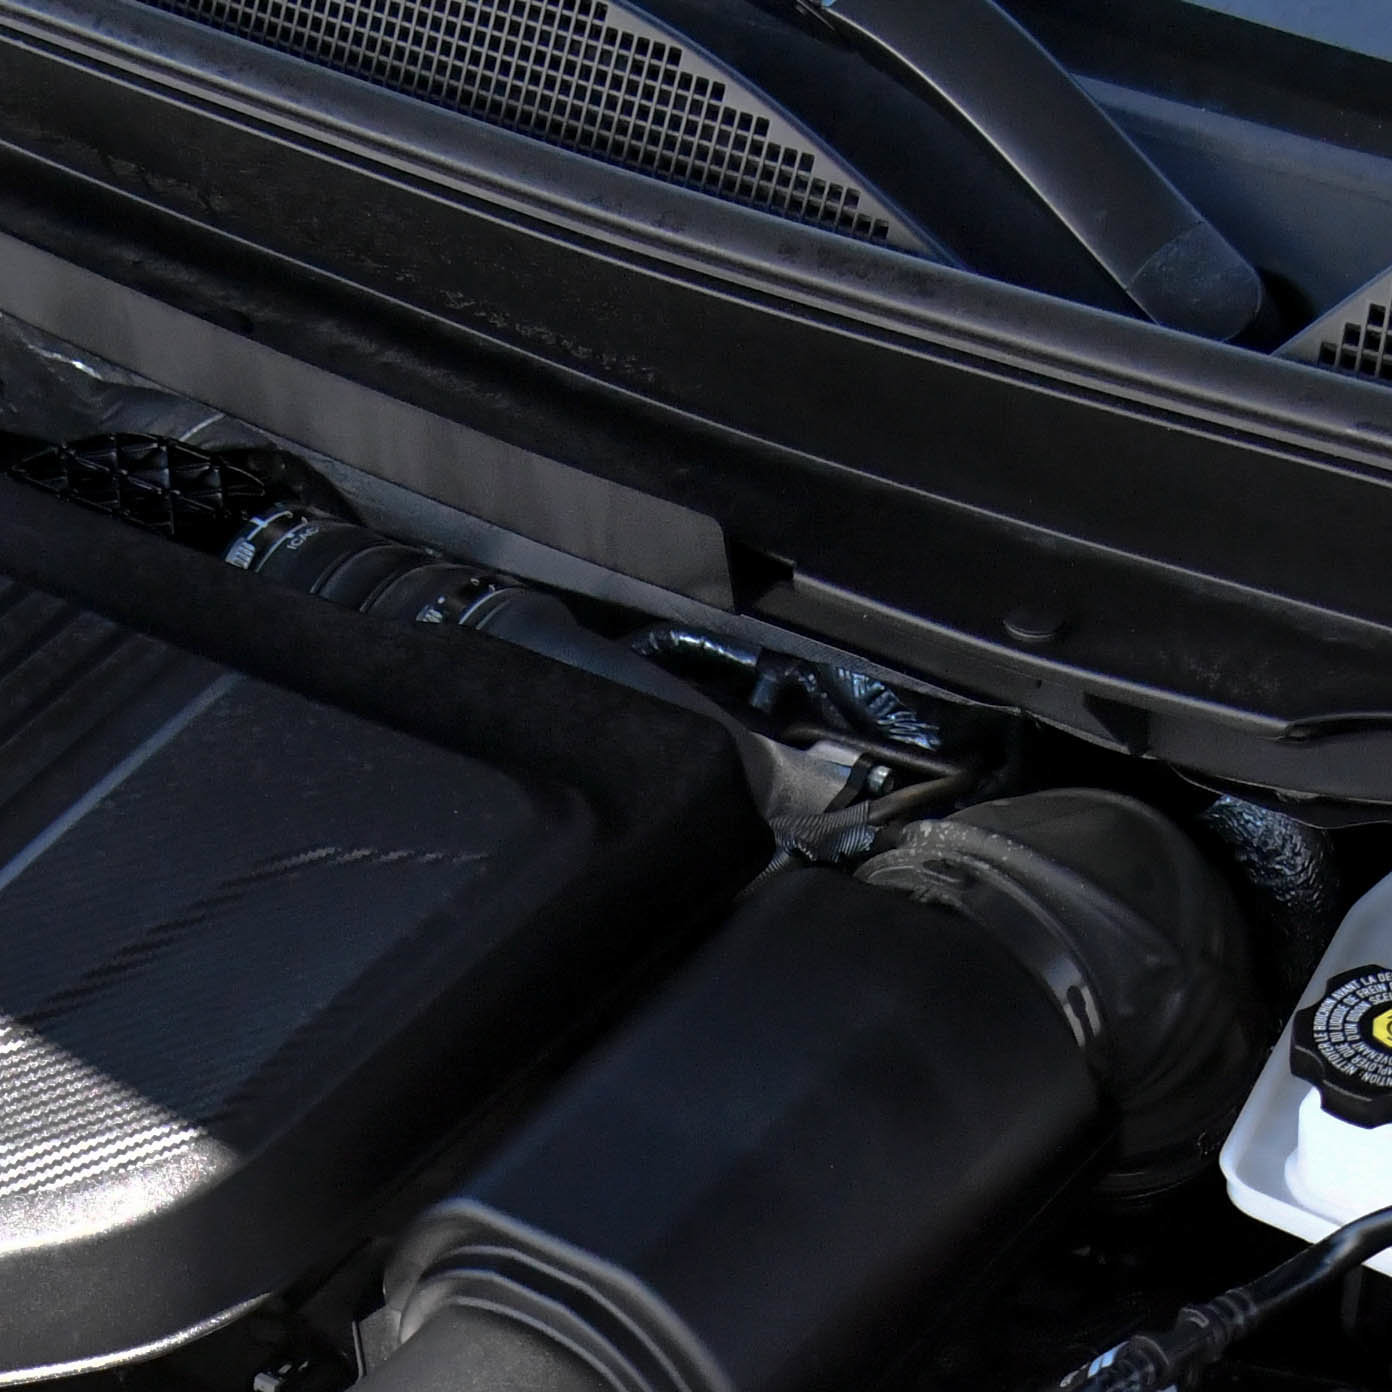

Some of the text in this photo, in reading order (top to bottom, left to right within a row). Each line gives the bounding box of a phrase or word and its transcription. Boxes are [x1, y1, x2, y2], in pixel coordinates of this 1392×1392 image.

[1359, 974, 1377, 986] LA
[1331, 979, 1361, 1000] AVANT
[1355, 983, 1387, 998] FREIN
[1342, 993, 1360, 1006] DE
[1313, 997, 1337, 1030] BOUCHON
[1313, 1031, 1328, 1042] LE
[1329, 1031, 1345, 1042] DU
[1334, 1041, 1356, 1058] QUE
[1317, 1041, 1359, 1075] NETTOYER
